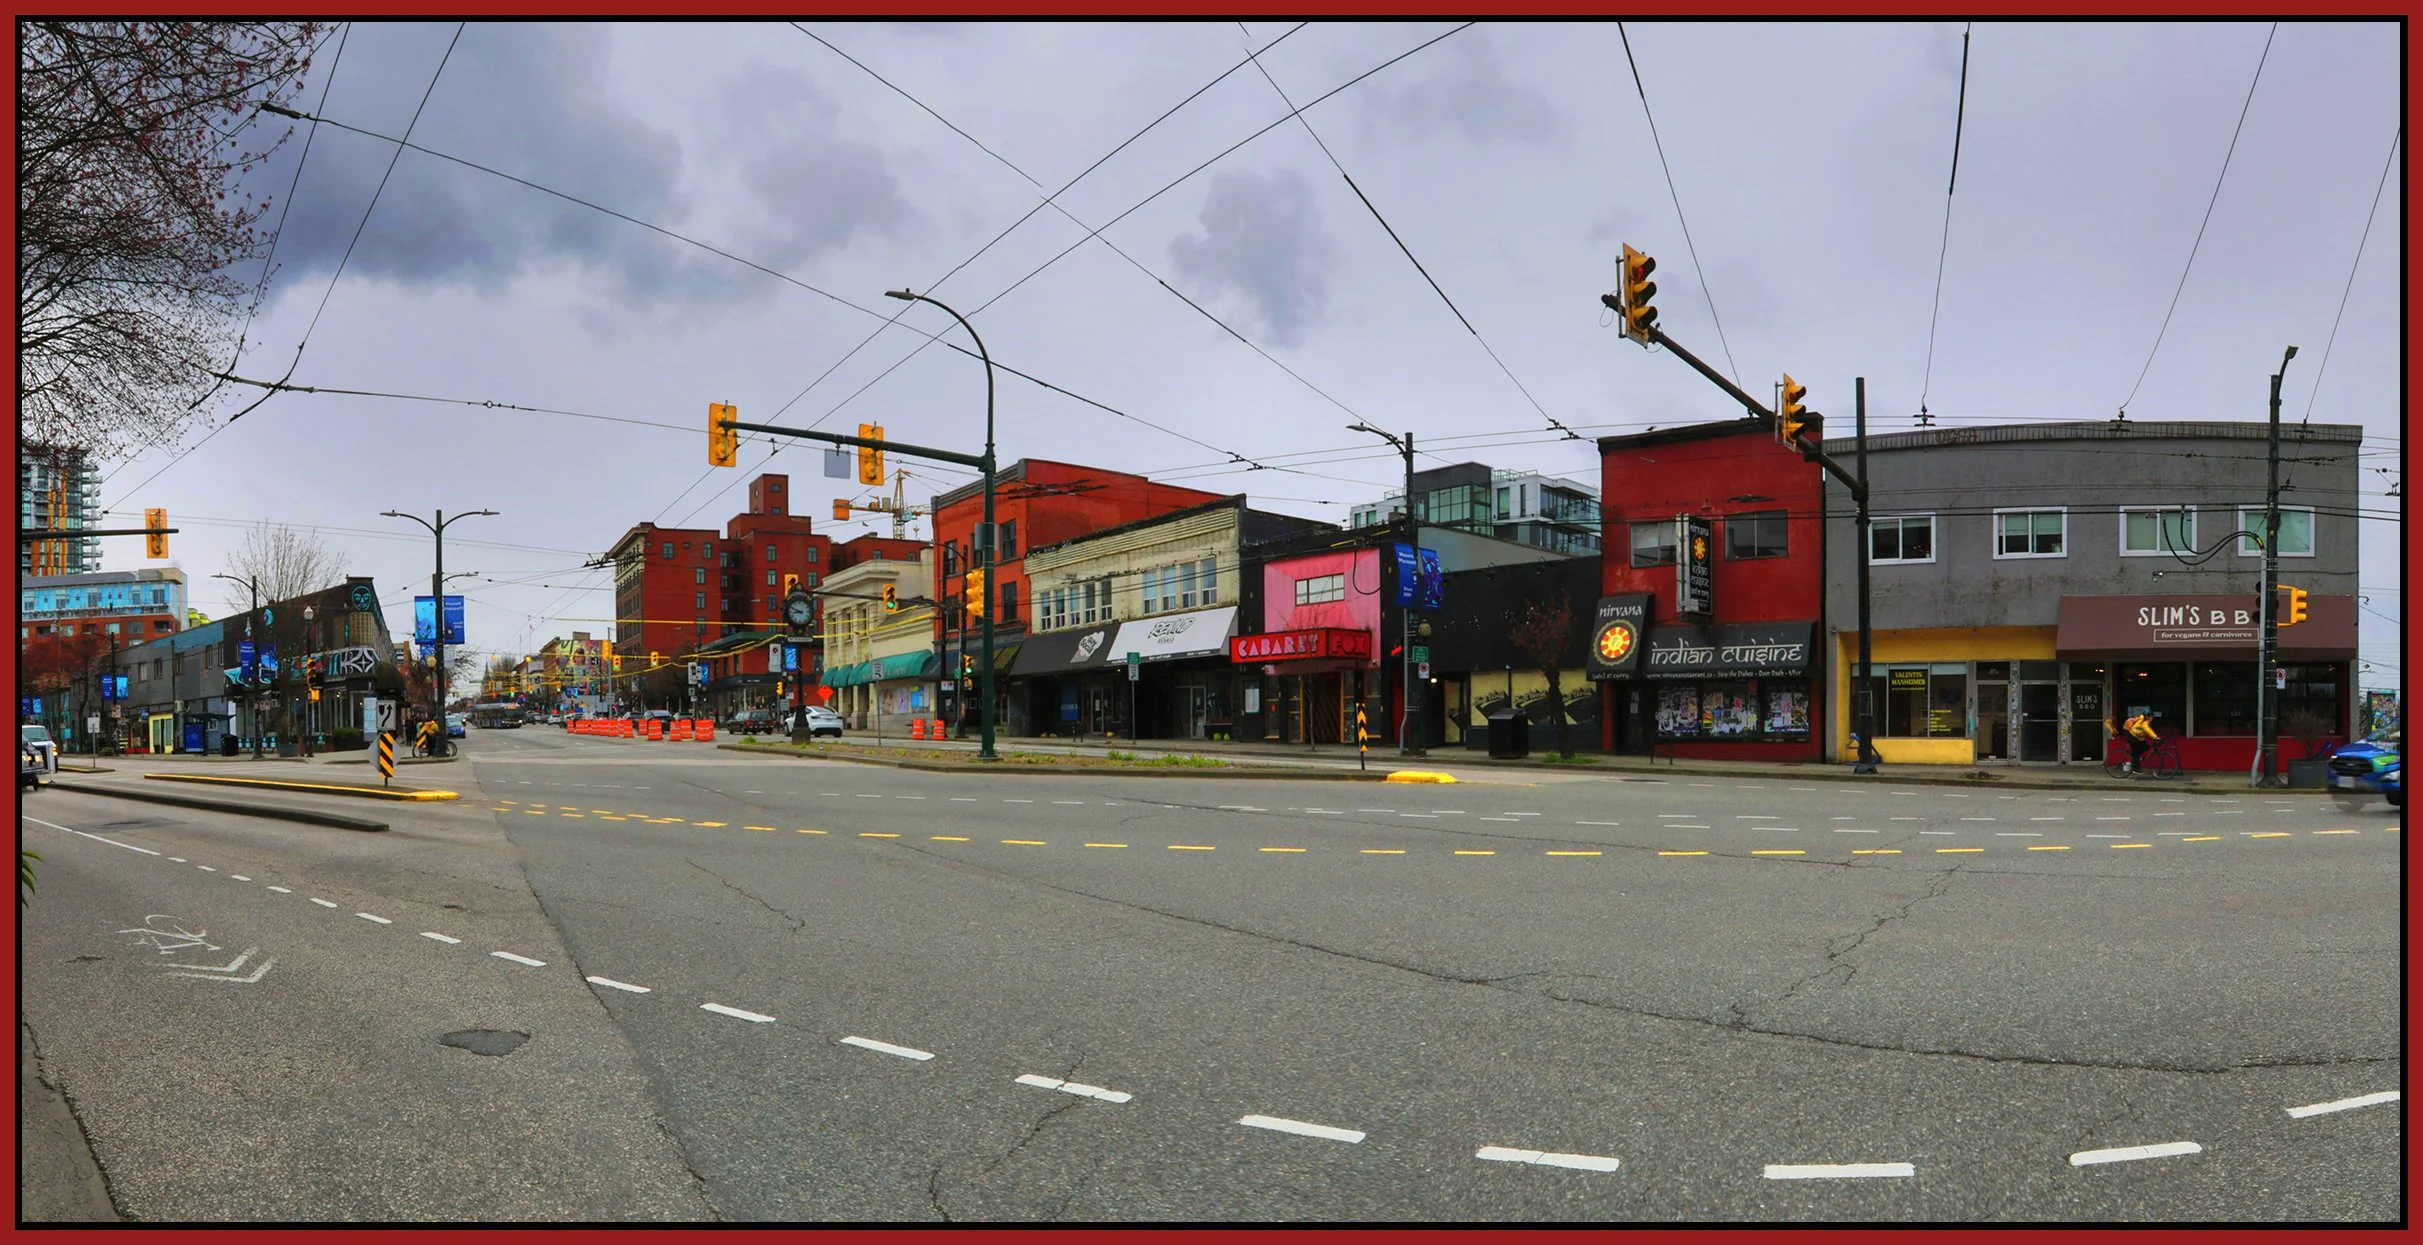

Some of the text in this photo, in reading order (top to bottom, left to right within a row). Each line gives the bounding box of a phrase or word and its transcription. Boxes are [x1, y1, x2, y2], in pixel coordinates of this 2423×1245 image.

[1599, 604, 1642, 618] nirvana
[2138, 605, 2200, 626] SLIM'S
[1238, 633, 1320, 658] CABARET
[1330, 633, 1368, 656] FOX
[1650, 638, 1804, 666] indian cuisine
[2076, 695, 2098, 704] SLIM'S
